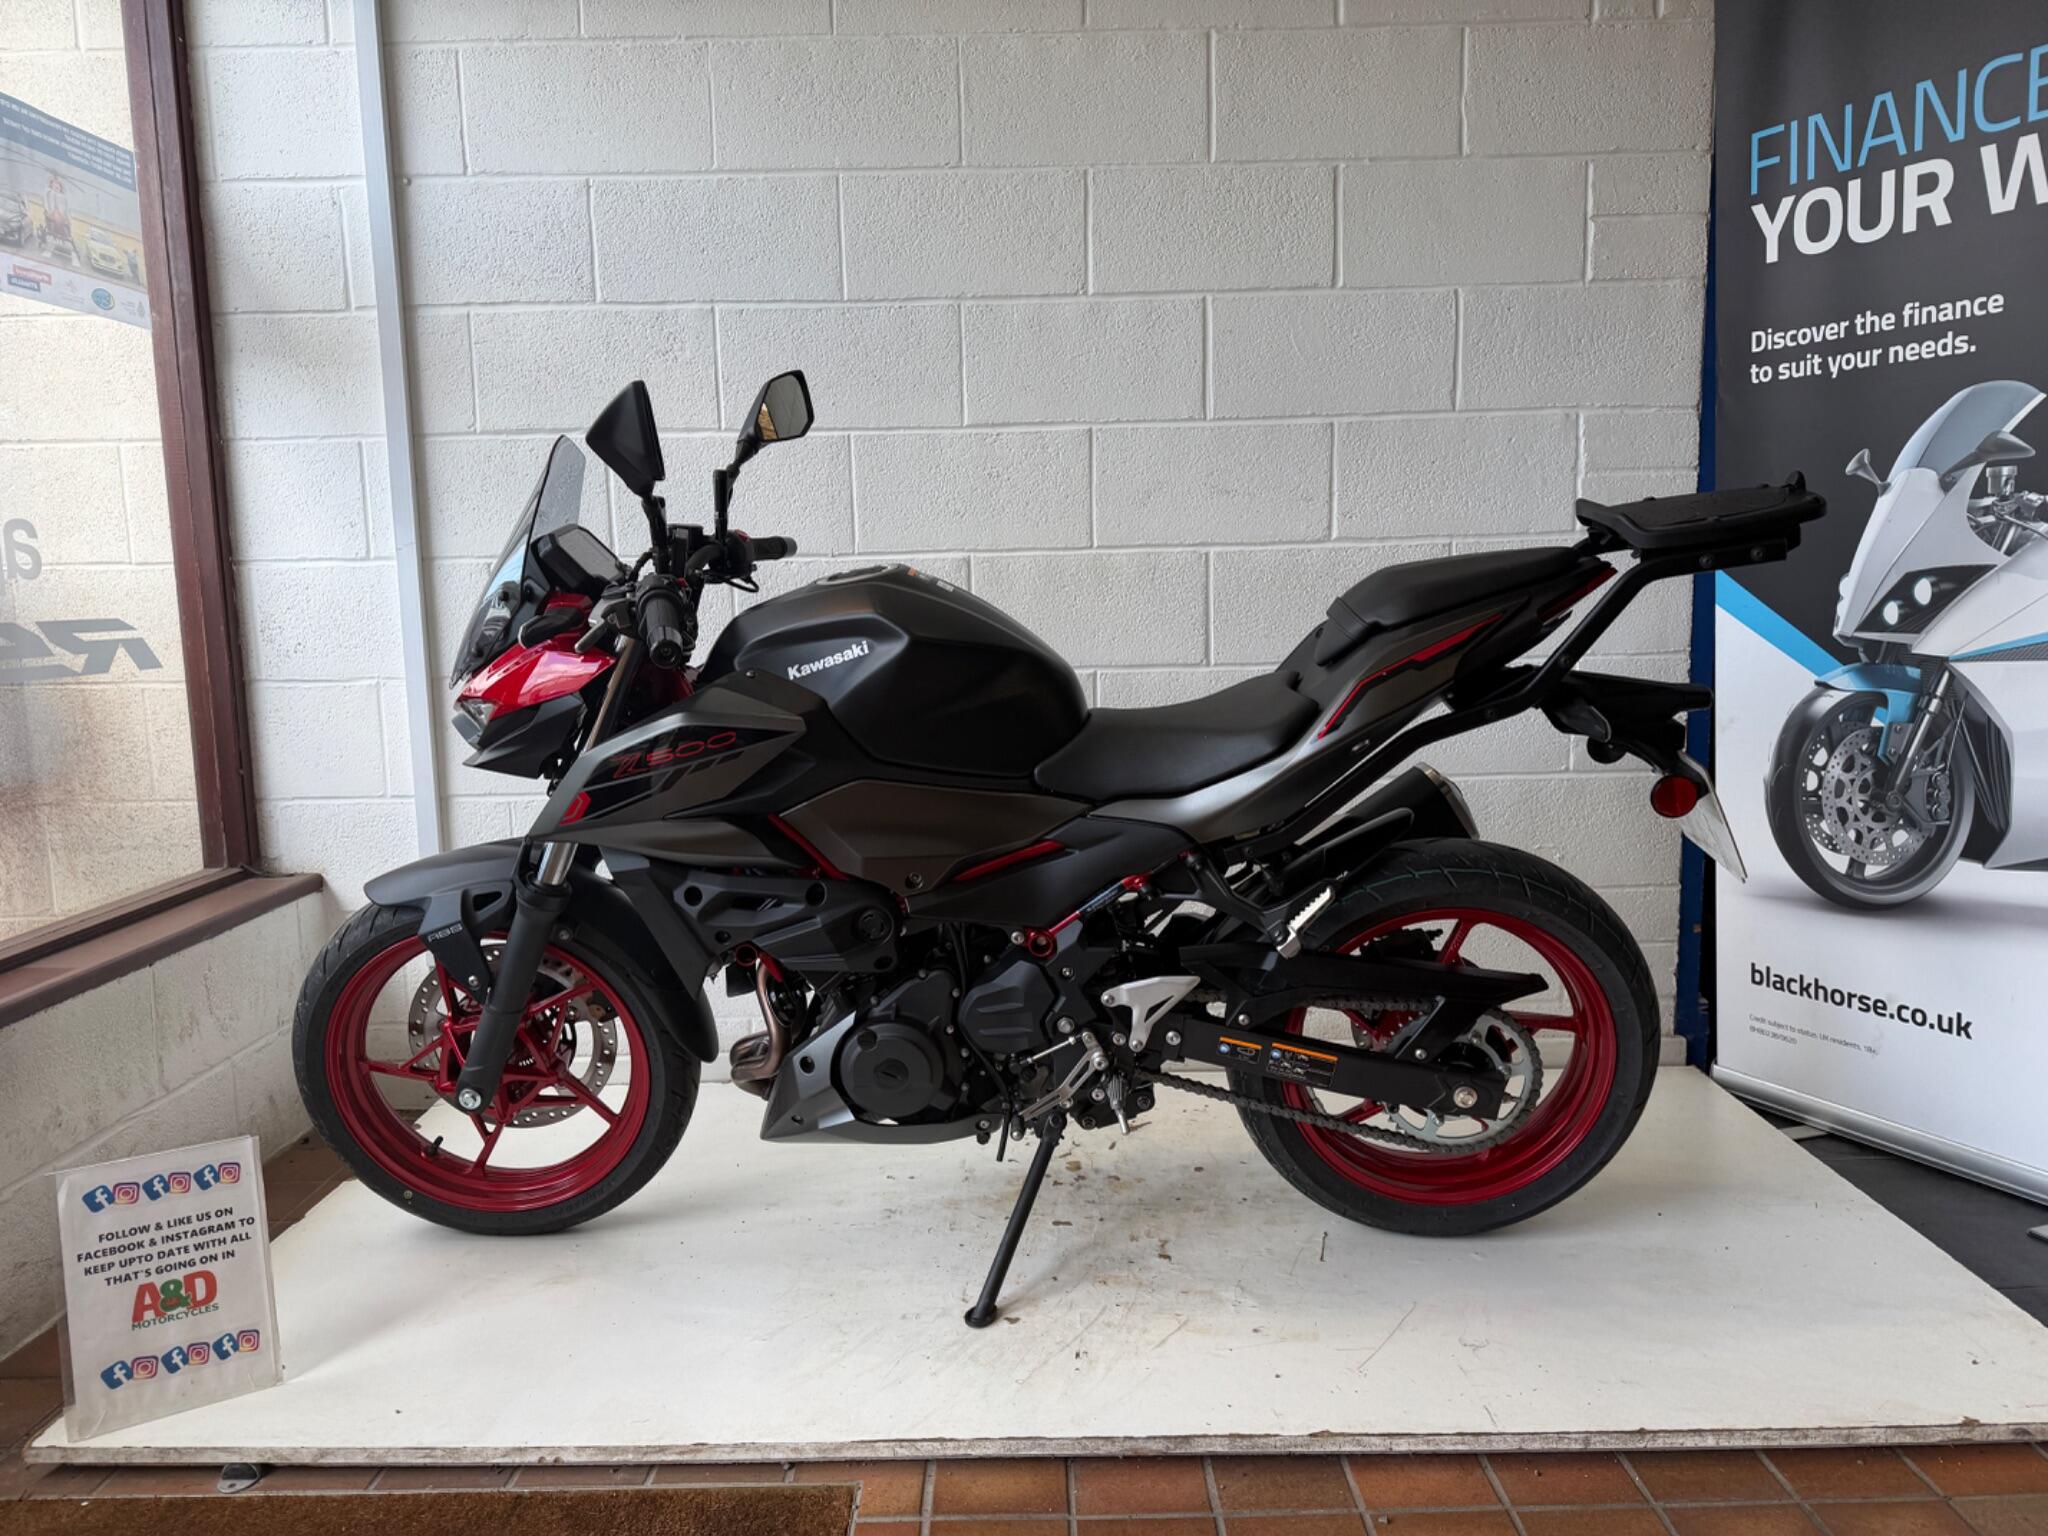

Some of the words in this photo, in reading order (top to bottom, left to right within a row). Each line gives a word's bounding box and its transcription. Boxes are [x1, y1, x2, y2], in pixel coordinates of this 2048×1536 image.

[1751, 43, 2048, 196] FINANCE
[1751, 158, 1954, 264] YOUR
[1751, 319, 1850, 353] Discover
[1855, 310, 1896, 336] the
[1902, 293, 2005, 328] finance
[1750, 363, 1773, 384] to
[1778, 353, 1822, 381] suit
[1828, 347, 1883, 379] your
[1889, 331, 1977, 365] needs.
[787, 640, 869, 681] Kawasaki
[1750, 962, 1973, 1041] blackhorse.co.uk
[76, 1240, 145, 1263] FACEBOOK
[148, 1238, 157, 1247] &
[161, 1222, 236, 1245] INSTAGRAM
[239, 1217, 255, 1227] TO
[98, 1224, 150, 1243] FOLLOW
[154, 1222, 164, 1231] &
[167, 1215, 193, 1229] LIKE
[196, 1211, 211, 1222] US
[214, 1207, 234, 1218] ON
[84, 1262, 115, 1276] KEEP
[118, 1253, 153, 1268] UPTO
[157, 1246, 190, 1260] DATE
[193, 1237, 227, 1251] WITH
[230, 1232, 252, 1244] ALL
[104, 1268, 151, 1286] THAT'S
[155, 1258, 197, 1275] GOING
[199, 1253, 218, 1264] ON
[221, 1249, 235, 1260] IN
[131, 1303, 220, 1331] MOTORCYCLES
[132, 1270, 217, 1324] A&D
